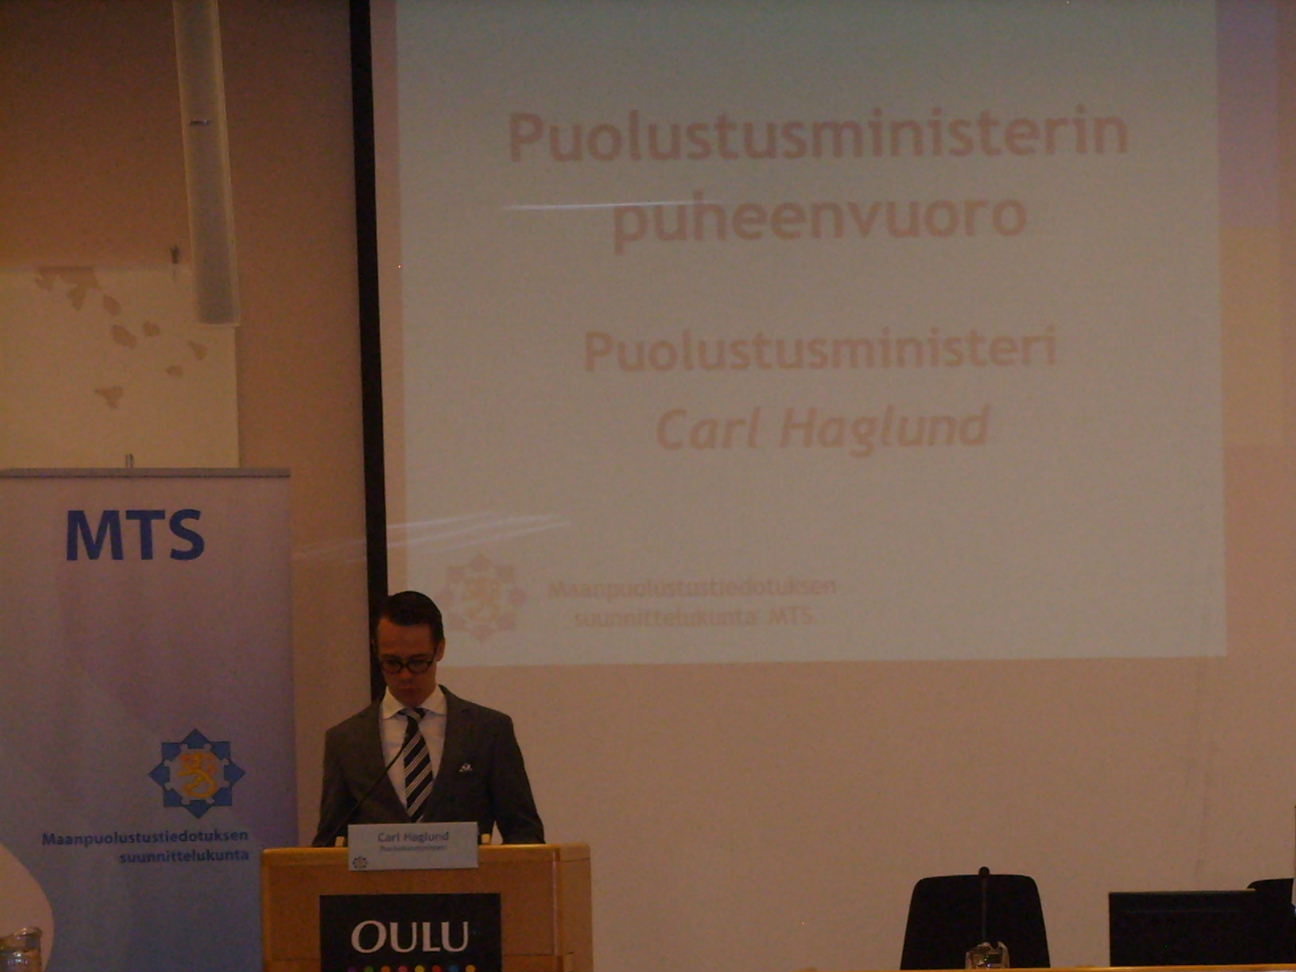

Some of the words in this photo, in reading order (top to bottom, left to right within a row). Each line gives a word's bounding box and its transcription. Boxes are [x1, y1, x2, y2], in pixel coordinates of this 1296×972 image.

[508, 105, 1128, 163] Puolustusministerin
[613, 191, 1028, 255] puheenvuoro
[584, 324, 1058, 373] Puolustusministeri
[655, 406, 762, 451] Carl
[780, 404, 991, 457] Haglund
[65, 508, 205, 561] MTS
[548, 575, 837, 602] Maanpuolustustiedotuksen
[574, 605, 757, 628] suunnittelukunta
[768, 605, 815, 626] MTS
[42, 828, 249, 848] Maanpuolustustiedotuksen
[377, 832, 400, 842] Carl
[403, 831, 449, 843] Haglund
[119, 849, 249, 864] suunnittelukunta
[351, 920, 469, 953] OULU
